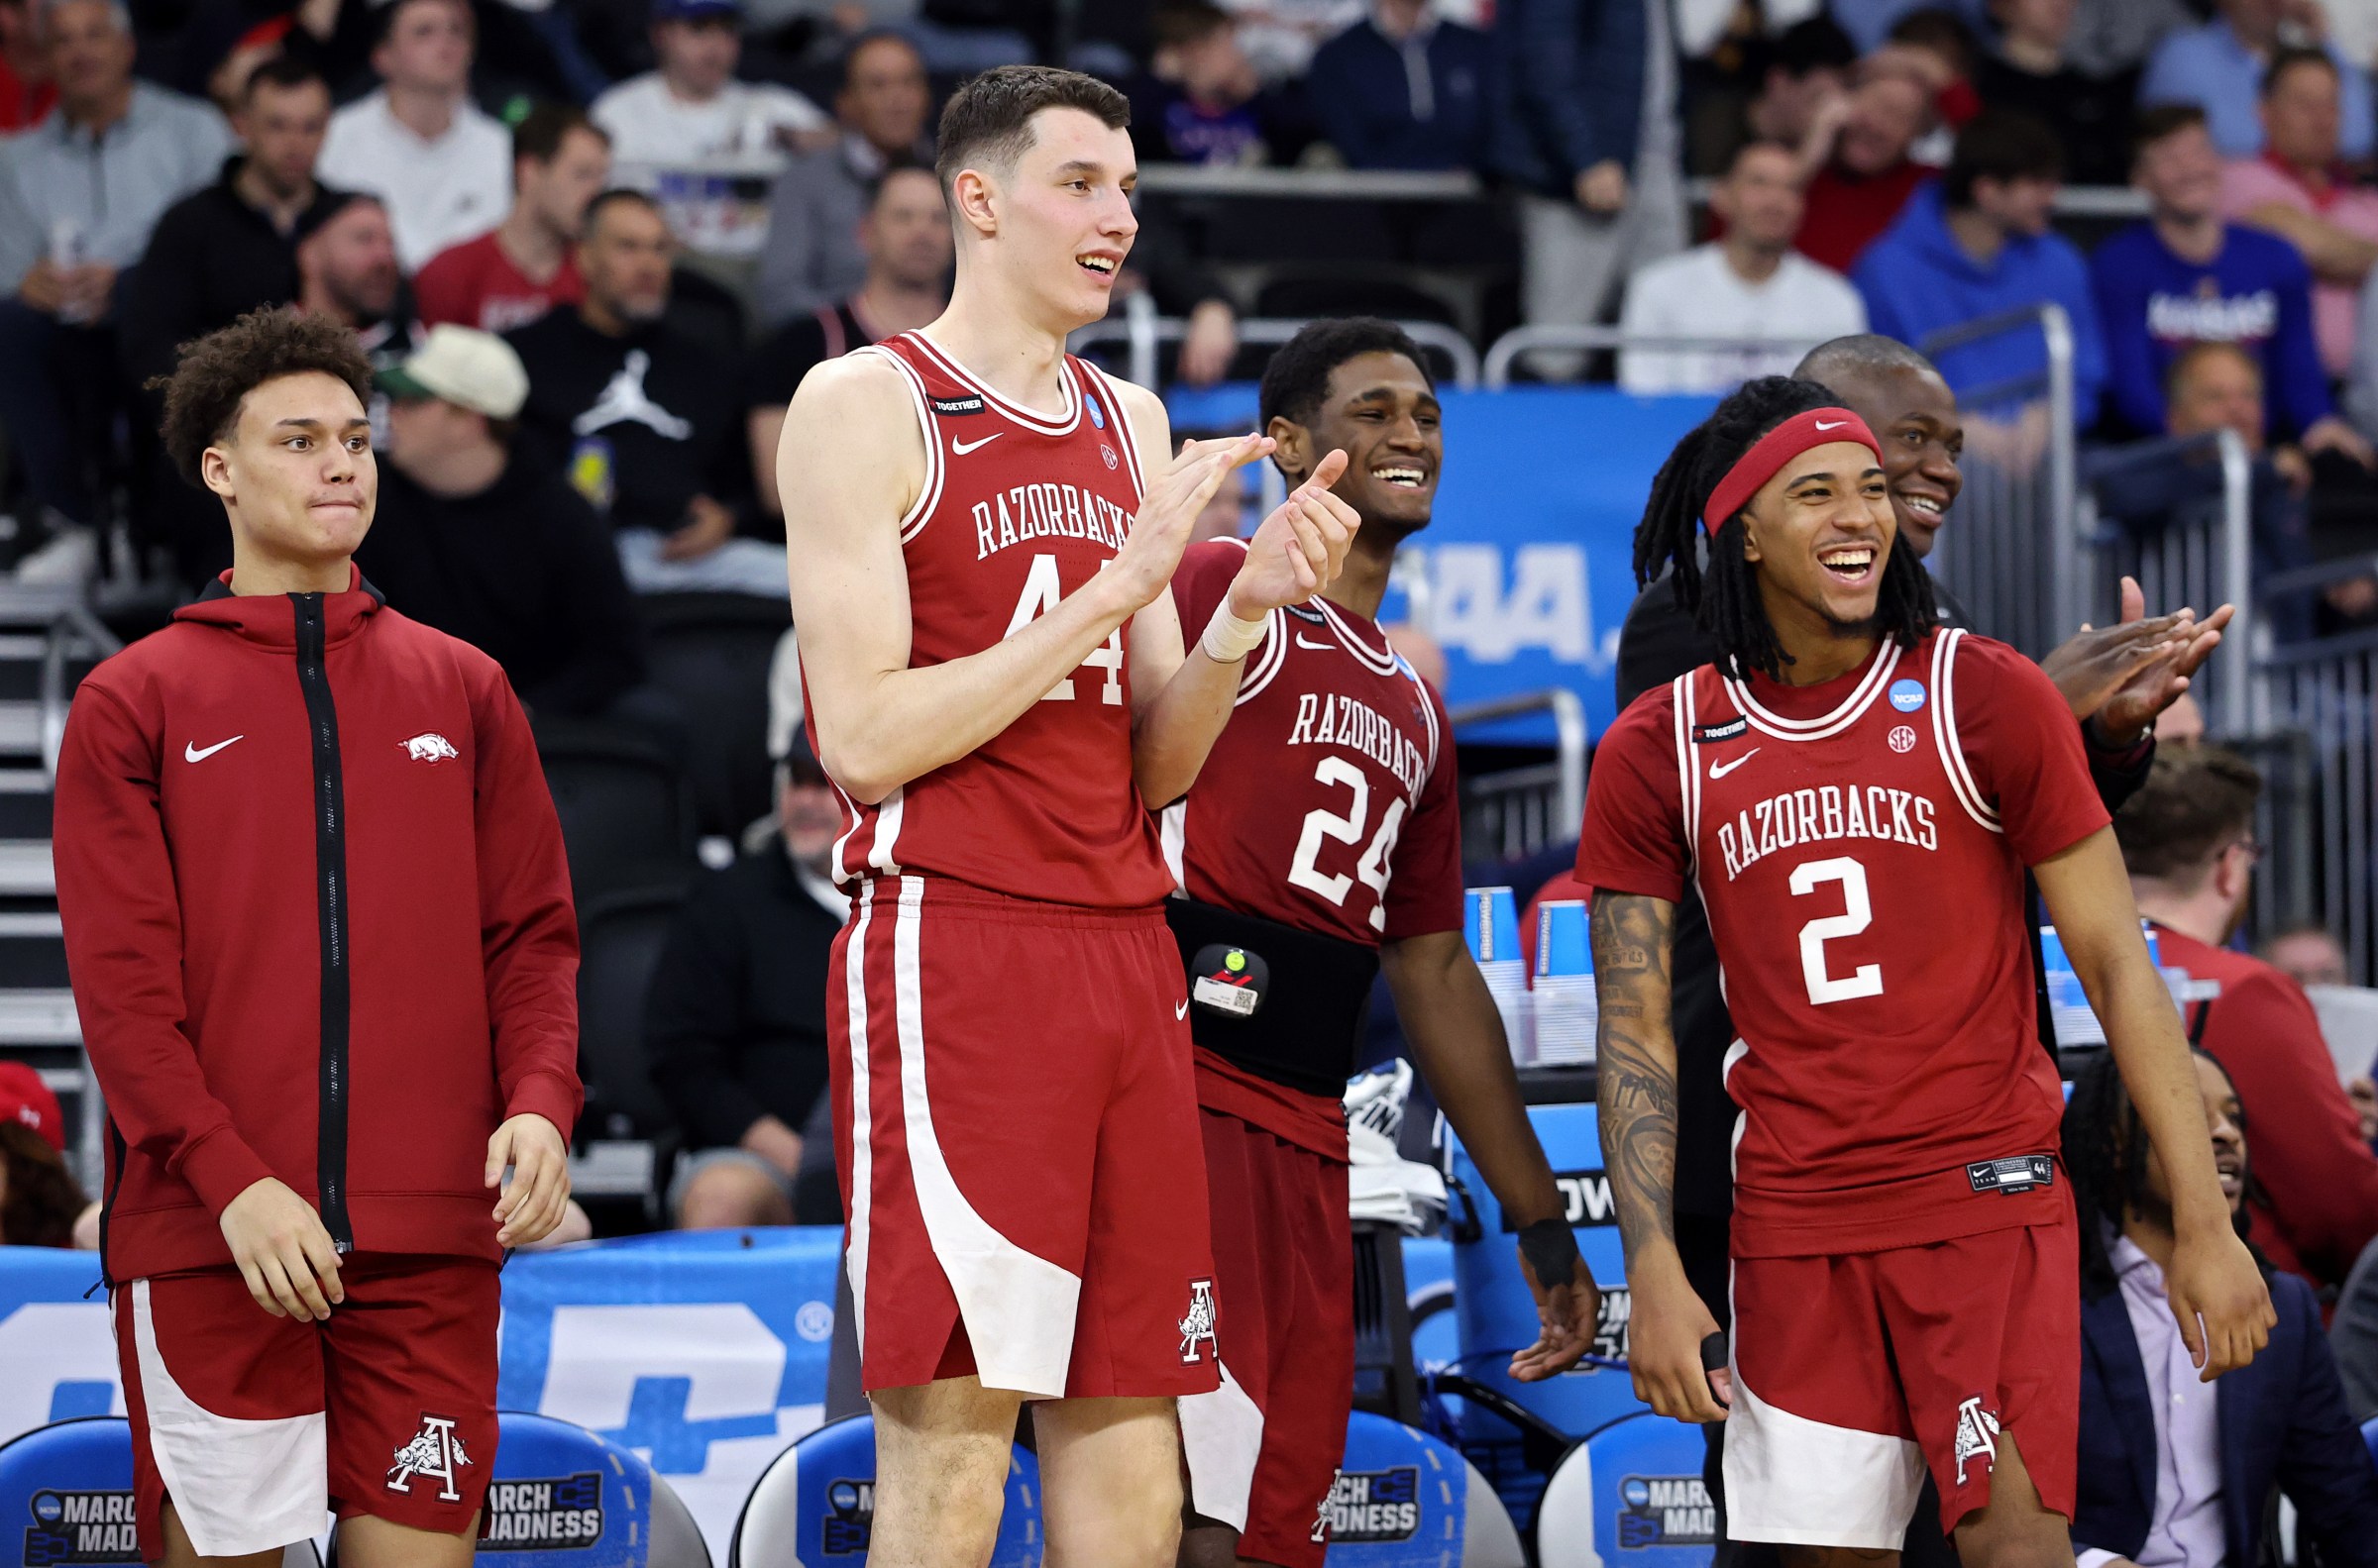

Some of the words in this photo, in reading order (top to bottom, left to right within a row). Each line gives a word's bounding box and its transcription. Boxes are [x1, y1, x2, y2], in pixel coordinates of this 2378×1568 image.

[936, 398, 982, 411] TOGETHER
[1429, 545, 1589, 663] AA
[1893, 693, 1923, 703] NCAA
[1704, 719, 1747, 738] TOGETHER
[1890, 727, 1914, 751] SEC
[1288, 755, 1408, 933] 24
[1717, 784, 1937, 882] RAZORBACKS
[1788, 856, 1884, 1005] 2
[2034, 1162, 2046, 1175] 44
[387, 1416, 460, 1501] A
[63, 1496, 137, 1523] MARC
[489, 1485, 551, 1514] ARCH
[489, 1509, 599, 1541] ADNESS
[1332, 1503, 1416, 1532] DNESS
